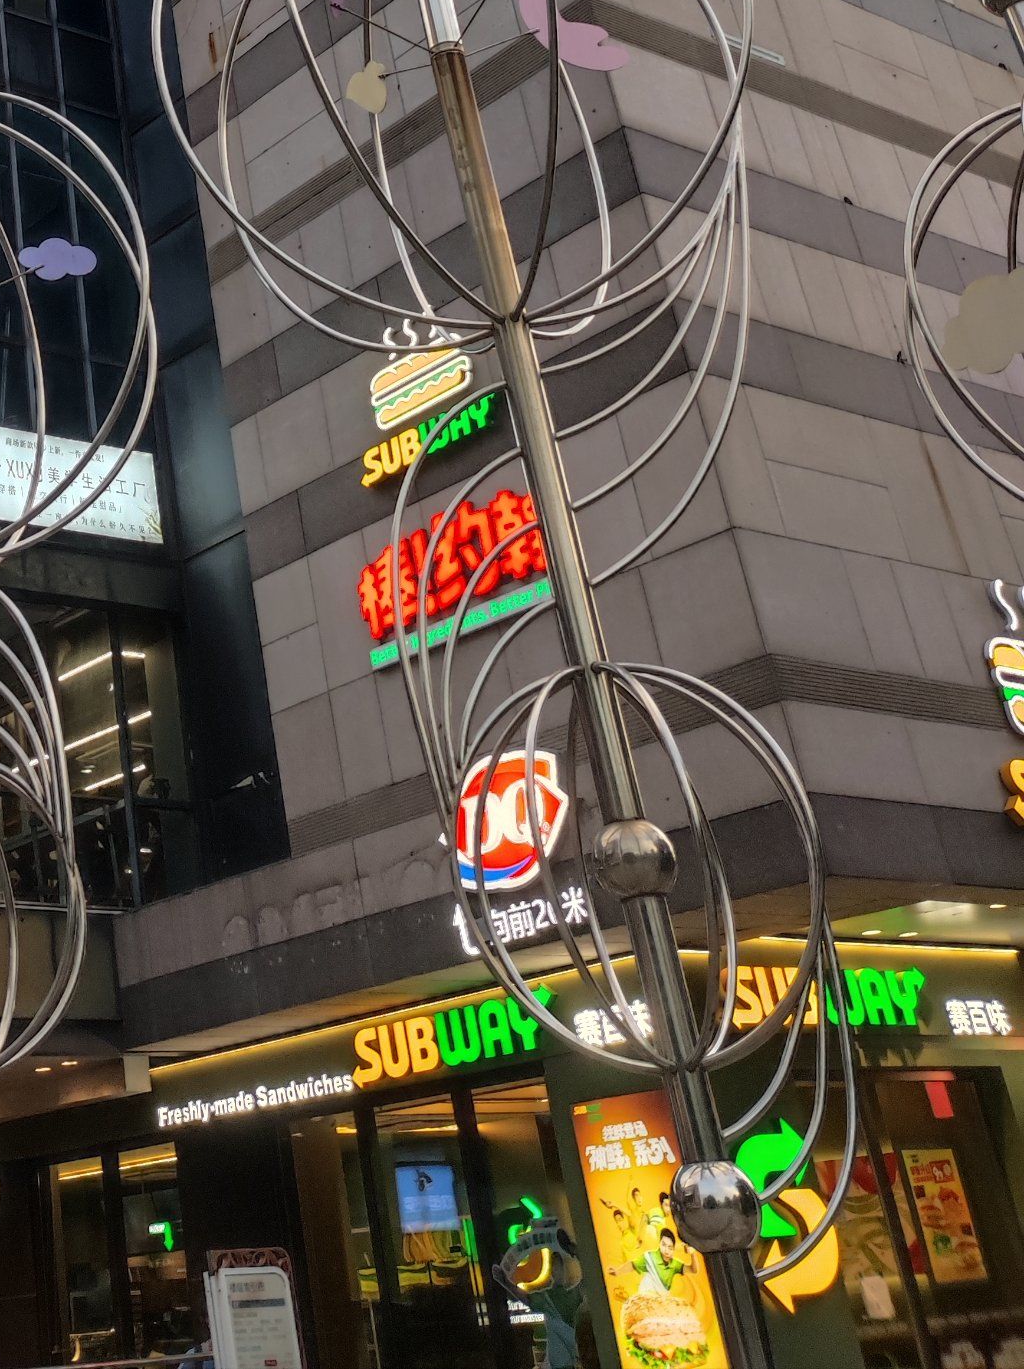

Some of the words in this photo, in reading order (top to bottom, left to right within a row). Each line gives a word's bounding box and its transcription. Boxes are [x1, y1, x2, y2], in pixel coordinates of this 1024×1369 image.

[361, 392, 496, 488] SUBWAY
[490, 590, 534, 619] Better
[460, 778, 550, 859] DQ
[158, 1090, 255, 1127] Freshly-made
[255, 1072, 353, 1108] Sandwiches
[352, 982, 552, 1090] SUBWAY
[946, 998, 1013, 1037] 赛百味
